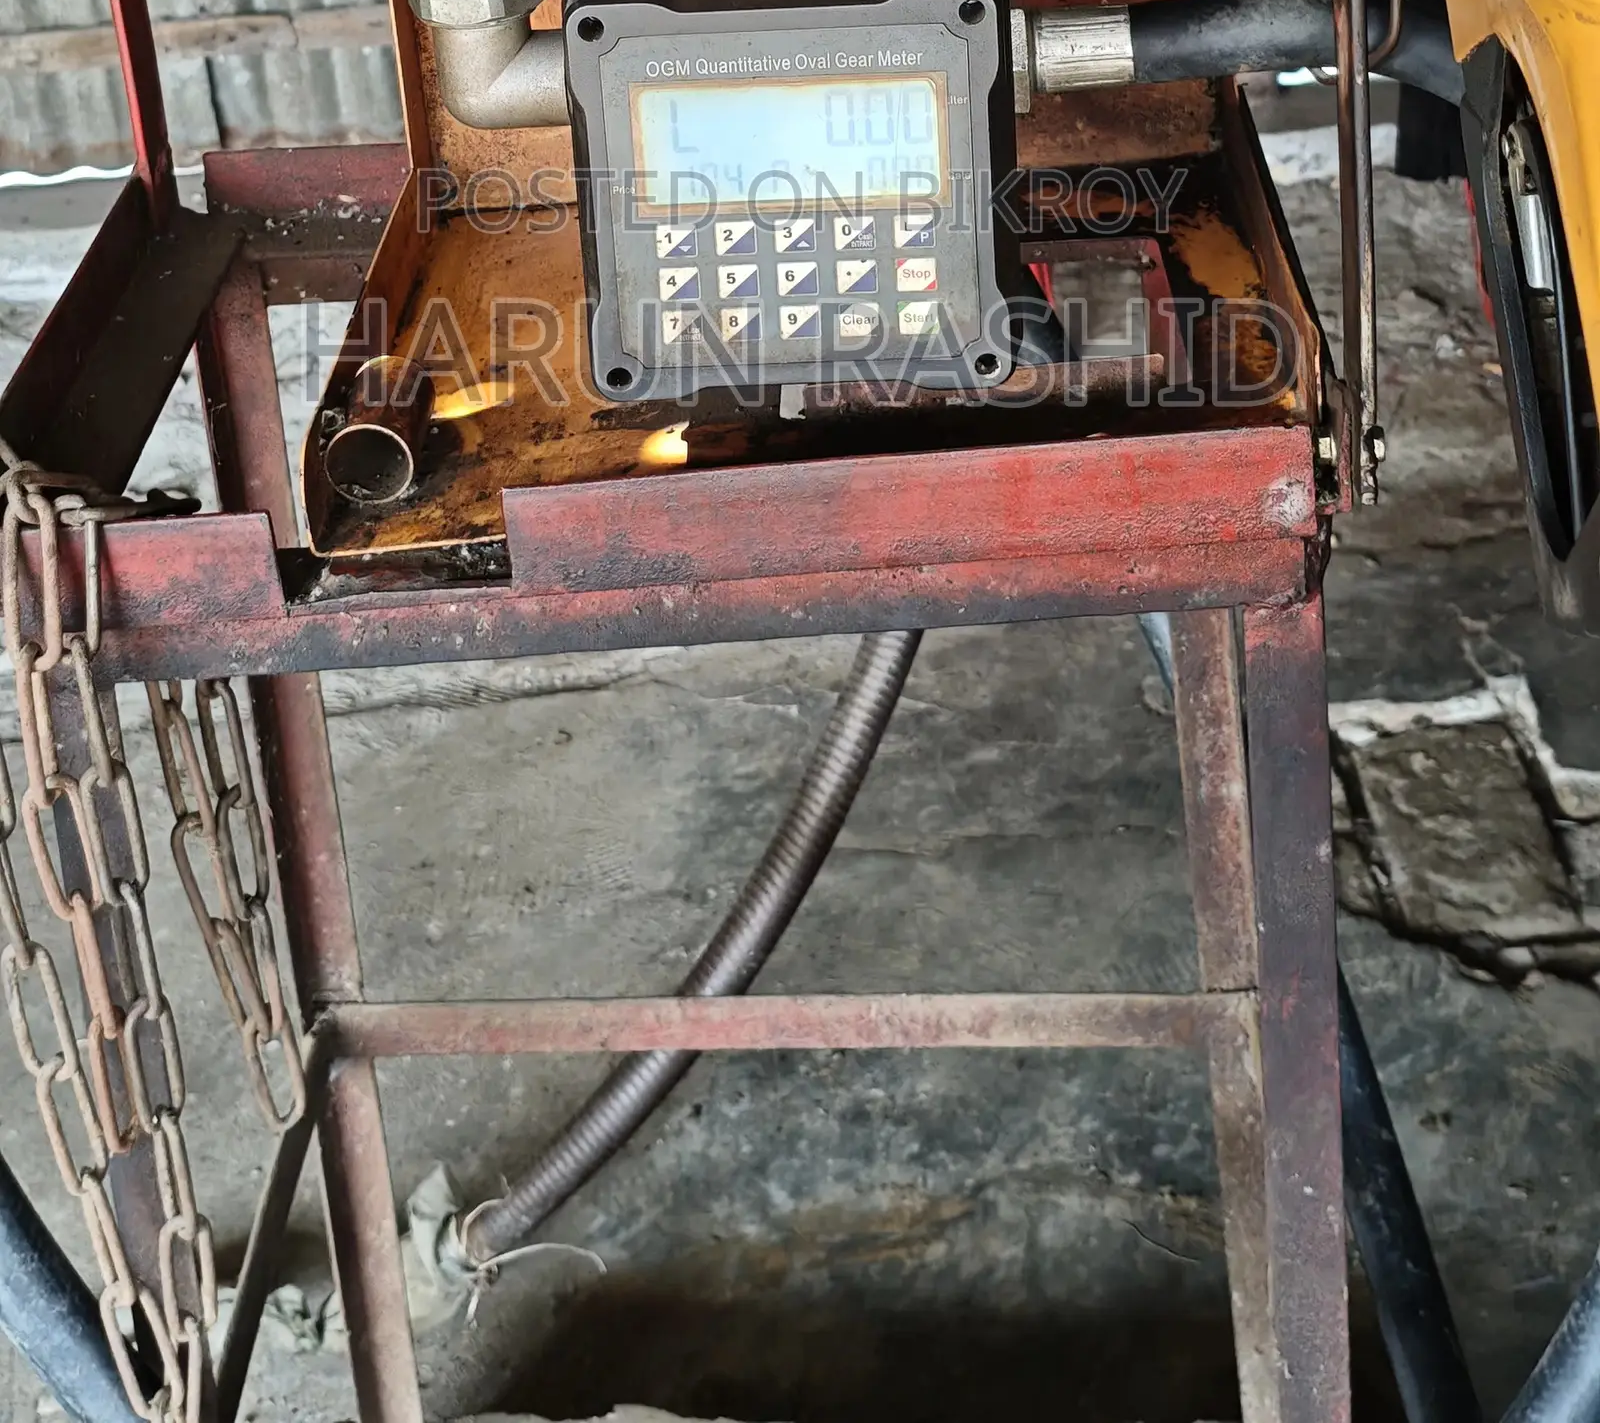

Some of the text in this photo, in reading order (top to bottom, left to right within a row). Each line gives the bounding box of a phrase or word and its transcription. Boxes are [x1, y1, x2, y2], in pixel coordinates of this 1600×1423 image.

[646, 50, 923, 78] OGM Quantitative Oval Gear Meter
[825, 86, 933, 146] 0.00
[723, 229, 733, 242] 2
[783, 227, 793, 239] 3
[842, 224, 852, 236] 0
[920, 232, 929, 243] P
[726, 273, 736, 285] 5
[785, 270, 795, 282] 6
[902, 269, 931, 280] Stop
[666, 275, 677, 287] 4
[669, 316, 679, 330] 7
[729, 316, 739, 328] 8
[787, 313, 797, 325] 9
[842, 310, 876, 325] Clear
[904, 313, 934, 323] Start
